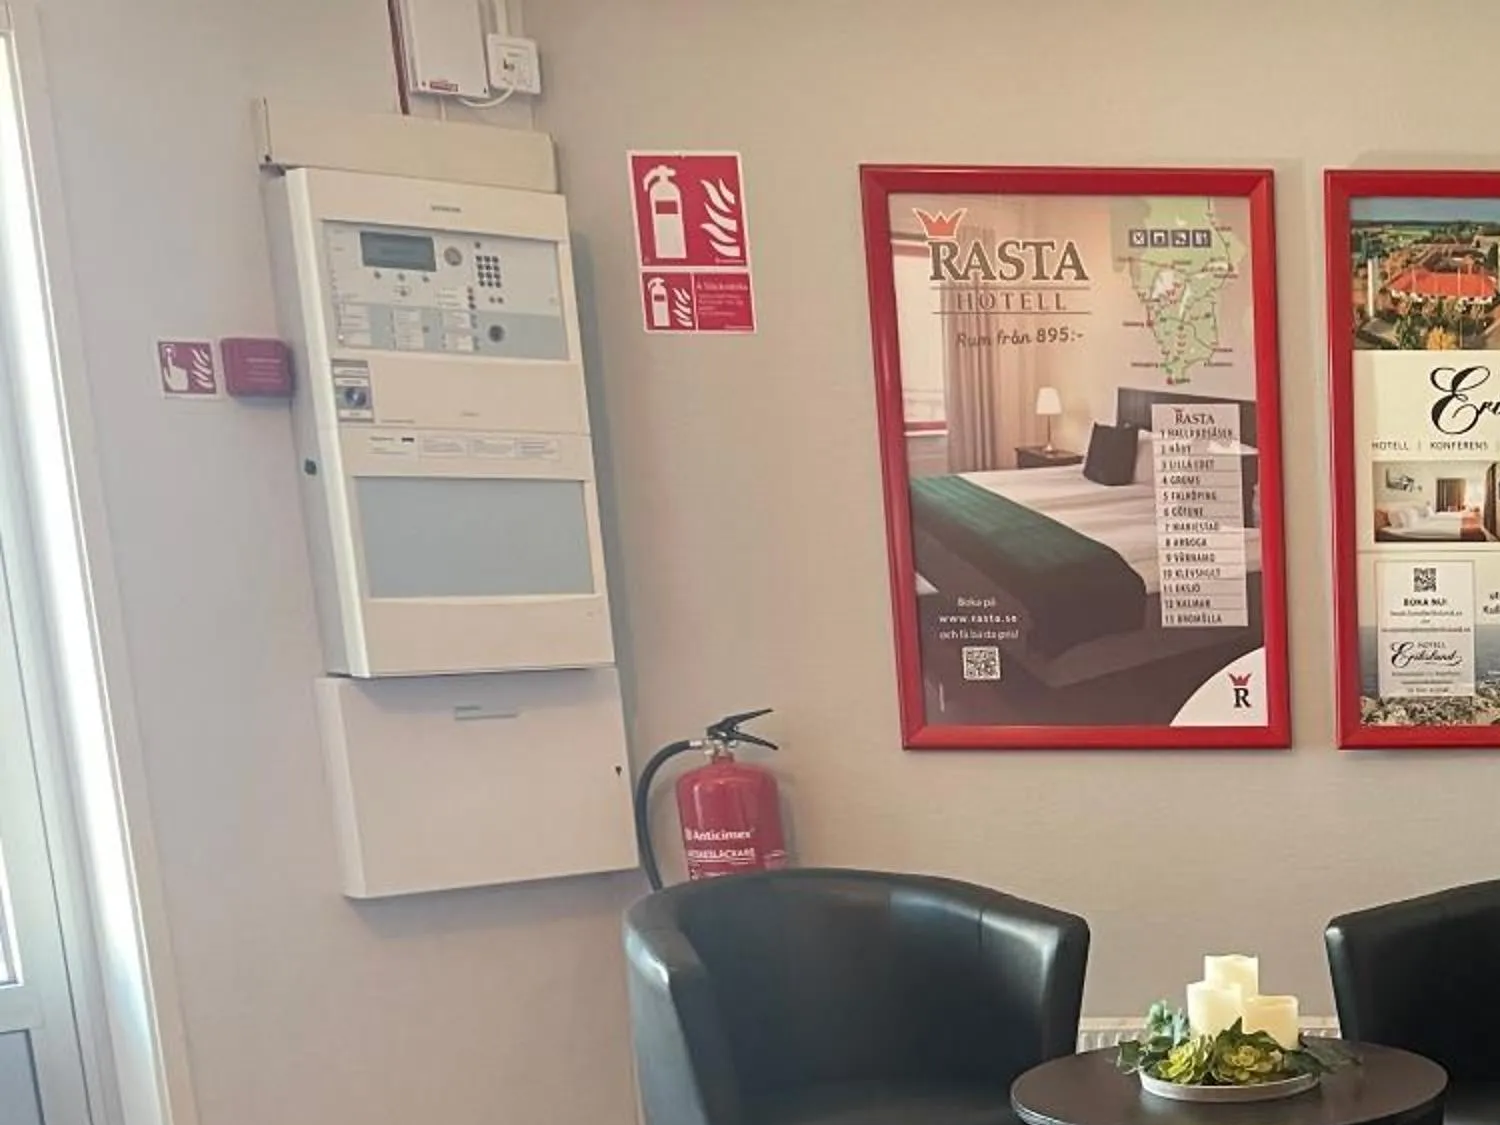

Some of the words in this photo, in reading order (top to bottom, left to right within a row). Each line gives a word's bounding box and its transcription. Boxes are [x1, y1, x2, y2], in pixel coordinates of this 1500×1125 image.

[929, 240, 1089, 282] RASTA
[956, 292, 1067, 311] HOTELL
[956, 332, 991, 347] Rum
[997, 330, 1031, 346] från
[1036, 328, 1084, 343] 895:-
[1175, 412, 1215, 425] RASTA
[1371, 440, 1409, 450] HOTELL
[1430, 440, 1489, 450] KONFERENS
[940, 614, 1017, 623] www.rasta.se
[1233, 688, 1251, 708] R
[693, 829, 752, 841] Anticimex
